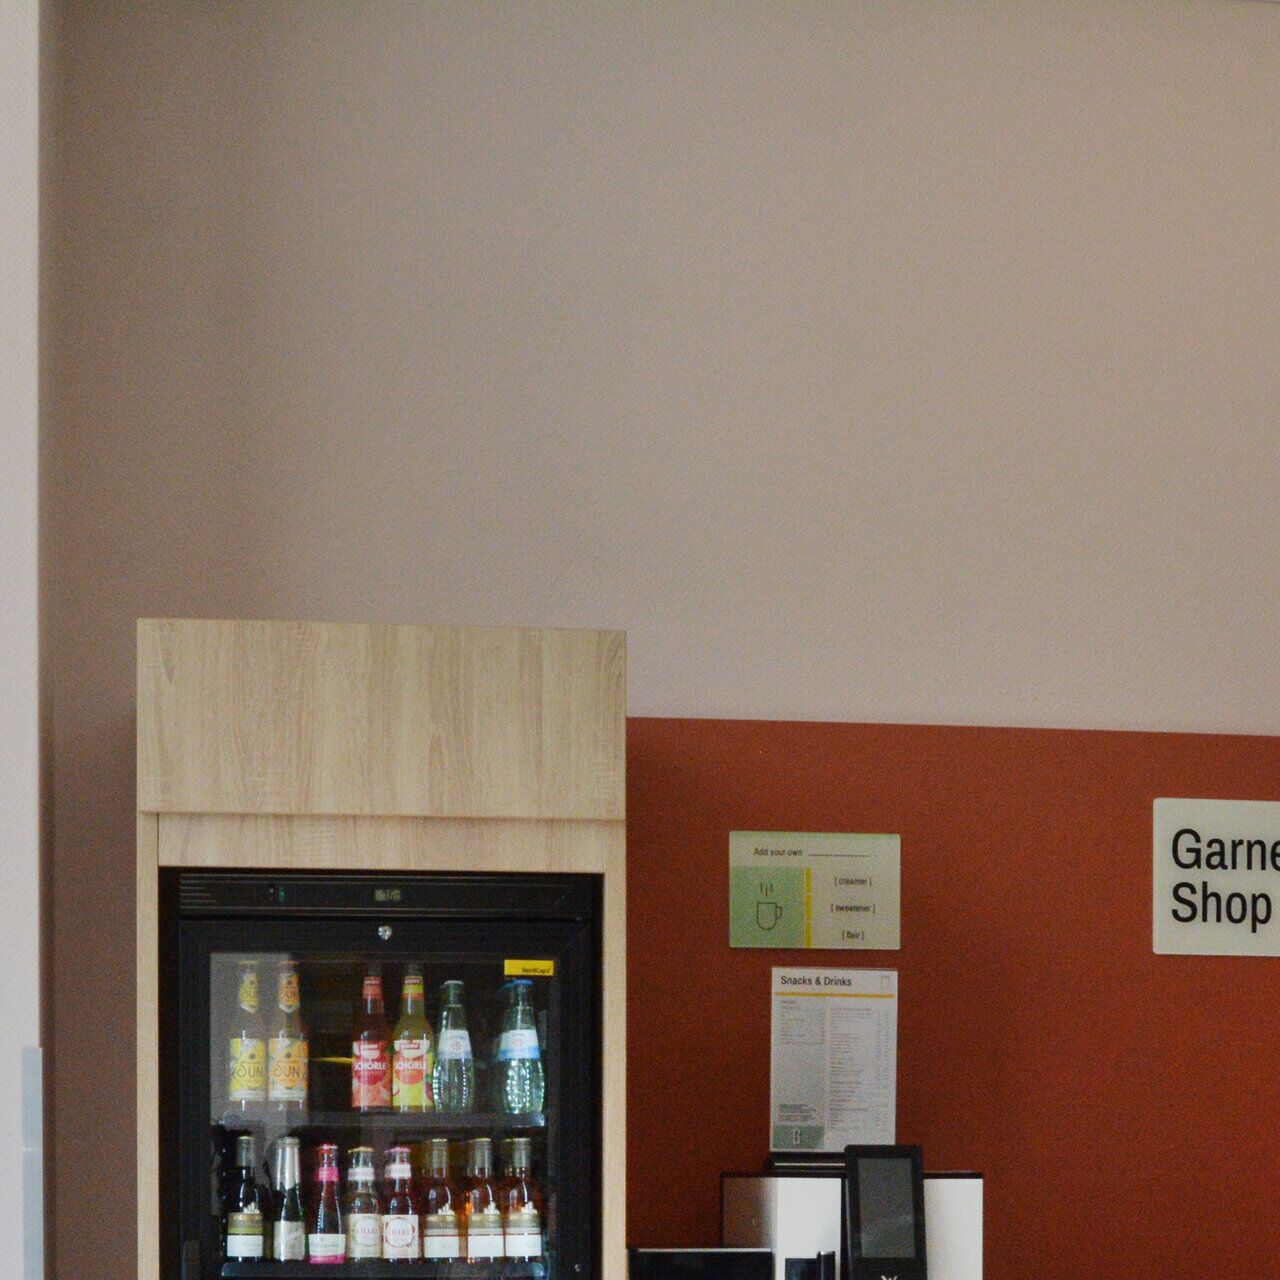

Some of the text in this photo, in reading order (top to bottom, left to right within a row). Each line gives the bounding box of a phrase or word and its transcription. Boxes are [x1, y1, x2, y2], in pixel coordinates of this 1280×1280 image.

[753, 848, 768, 856] Add
[770, 849, 786, 858] your
[1171, 881, 1272, 933] Shop
[780, 975, 852, 987] Snacks & Drinks
